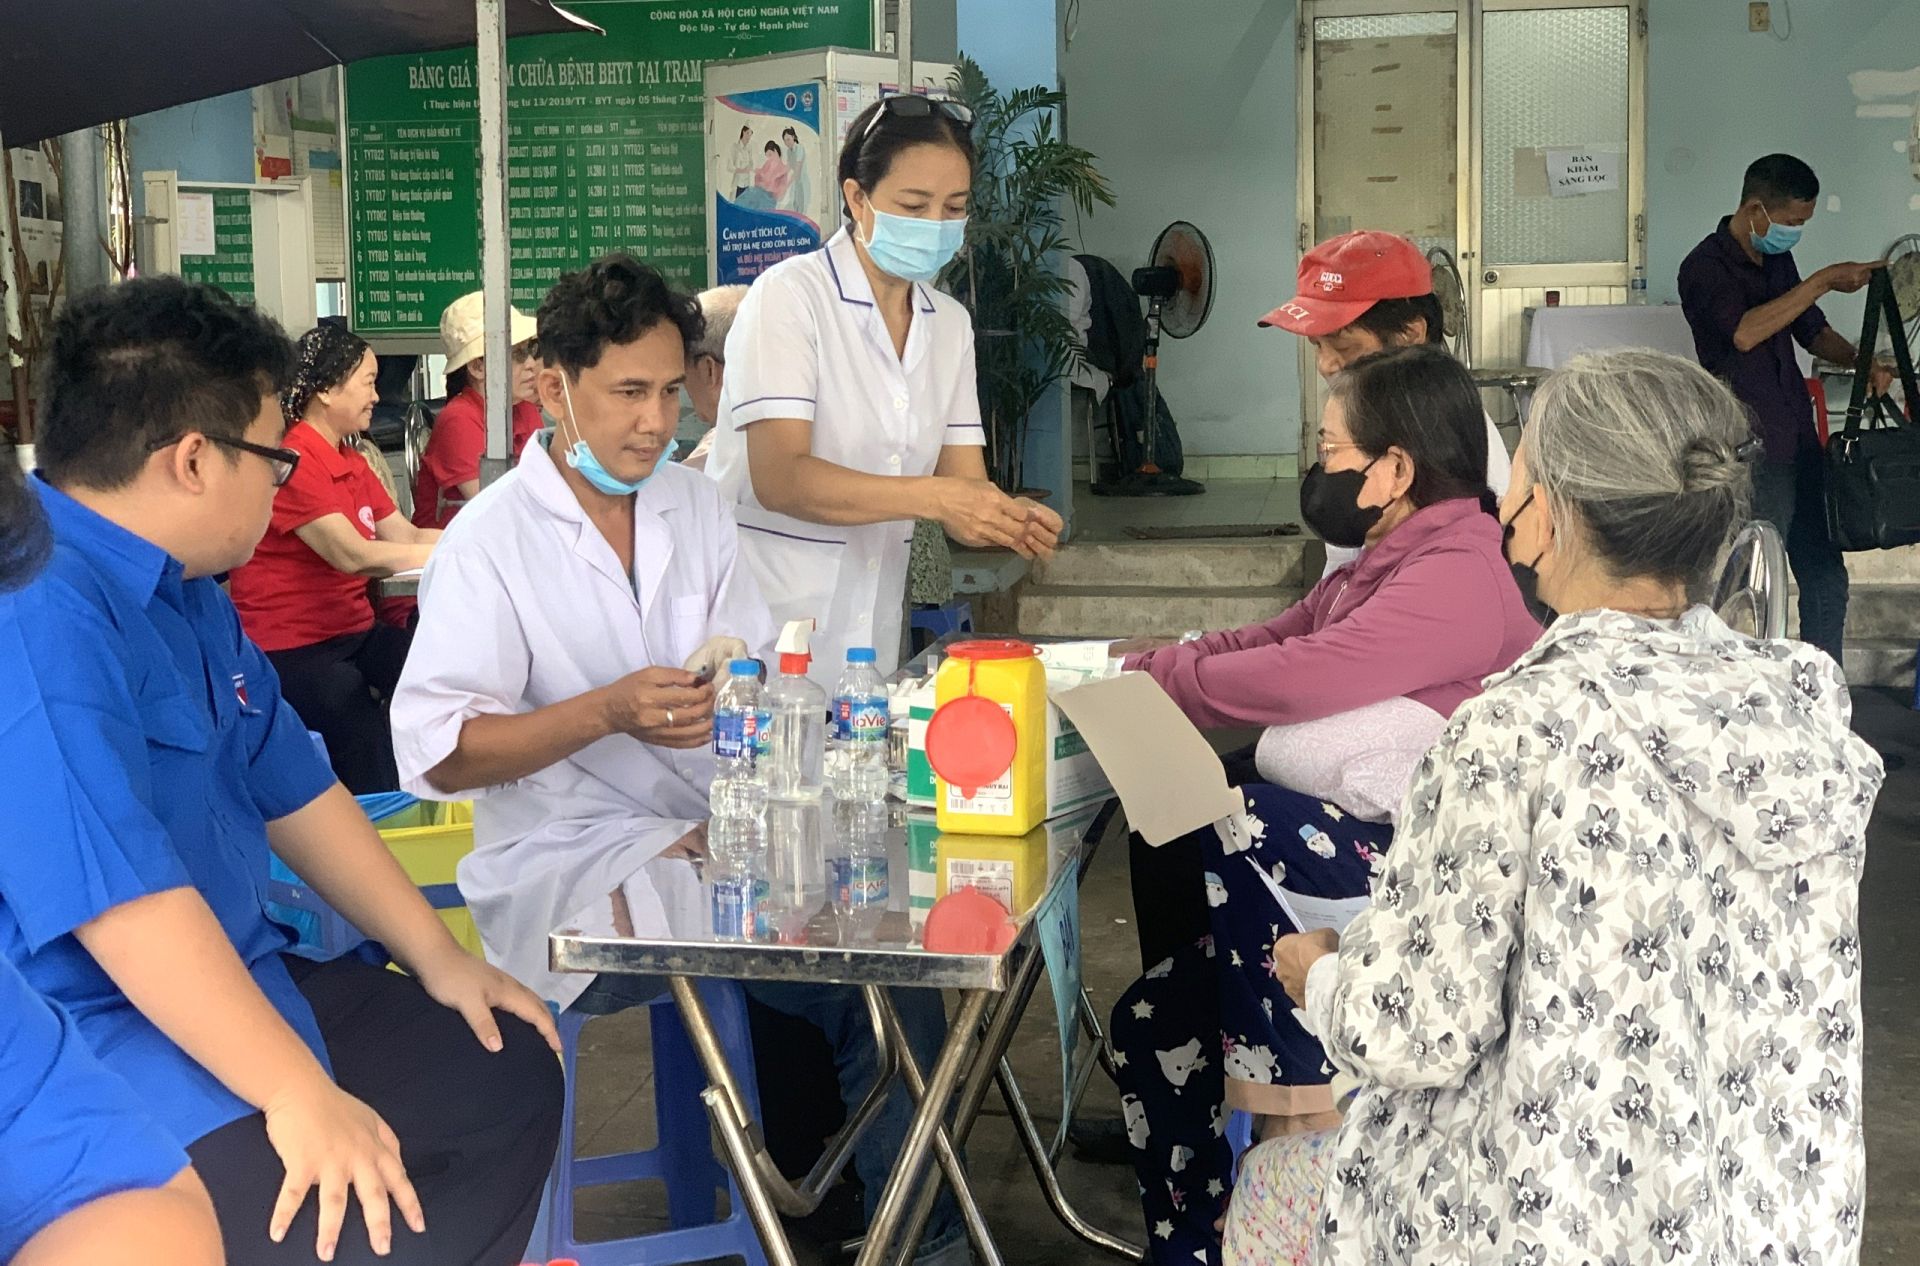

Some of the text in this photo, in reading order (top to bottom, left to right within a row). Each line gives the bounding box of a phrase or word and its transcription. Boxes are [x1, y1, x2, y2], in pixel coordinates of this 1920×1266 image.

[650, 10, 676, 21] CỘNG
[702, 8, 714, 18] XÃ
[718, 8, 734, 20] HỘI
[737, 6, 756, 18] CHỦ
[761, 6, 789, 17] NGHĨA
[792, 6, 814, 17] VIỆT
[818, 6, 839, 15] NAM
[679, 21, 809, 33] Độc lập Tự do Hạnh phúc
[409, 57, 445, 89] BẢNG
[448, 59, 472, 88] GIÁ
[518, 57, 555, 87] CHỮA
[558, 56, 595, 91] BỆNH
[598, 61, 634, 85] BHYT
[637, 61, 661, 89] TẠI
[663, 60, 702, 88] TRẠM
[453, 99, 471, 110] hiện
[595, 96, 612, 105] BYT
[615, 96, 636, 106] ngày
[638, 95, 650, 104] 05
[652, 95, 677, 105] tháng
[680, 94, 685, 103] 7
[353, 149, 358, 161] 1
[611, 144, 619, 156] 10
[354, 169, 359, 181] 2
[612, 164, 619, 176] 11
[1567, 164, 1599, 174] KHÁM
[1588, 174, 1608, 183] LỌC
[355, 190, 360, 202] 3
[612, 184, 620, 197] 12
[355, 209, 361, 222] 4
[613, 205, 620, 217] 13
[356, 230, 361, 242] 5
[614, 225, 621, 238] 14
[761, 241, 773, 249] CHO
[774, 240, 786, 248] CON
[357, 250, 362, 262] 6
[358, 271, 363, 282] 7
[359, 291, 364, 303] 8
[360, 311, 364, 323] 9
[852, 713, 886, 728] laVie
